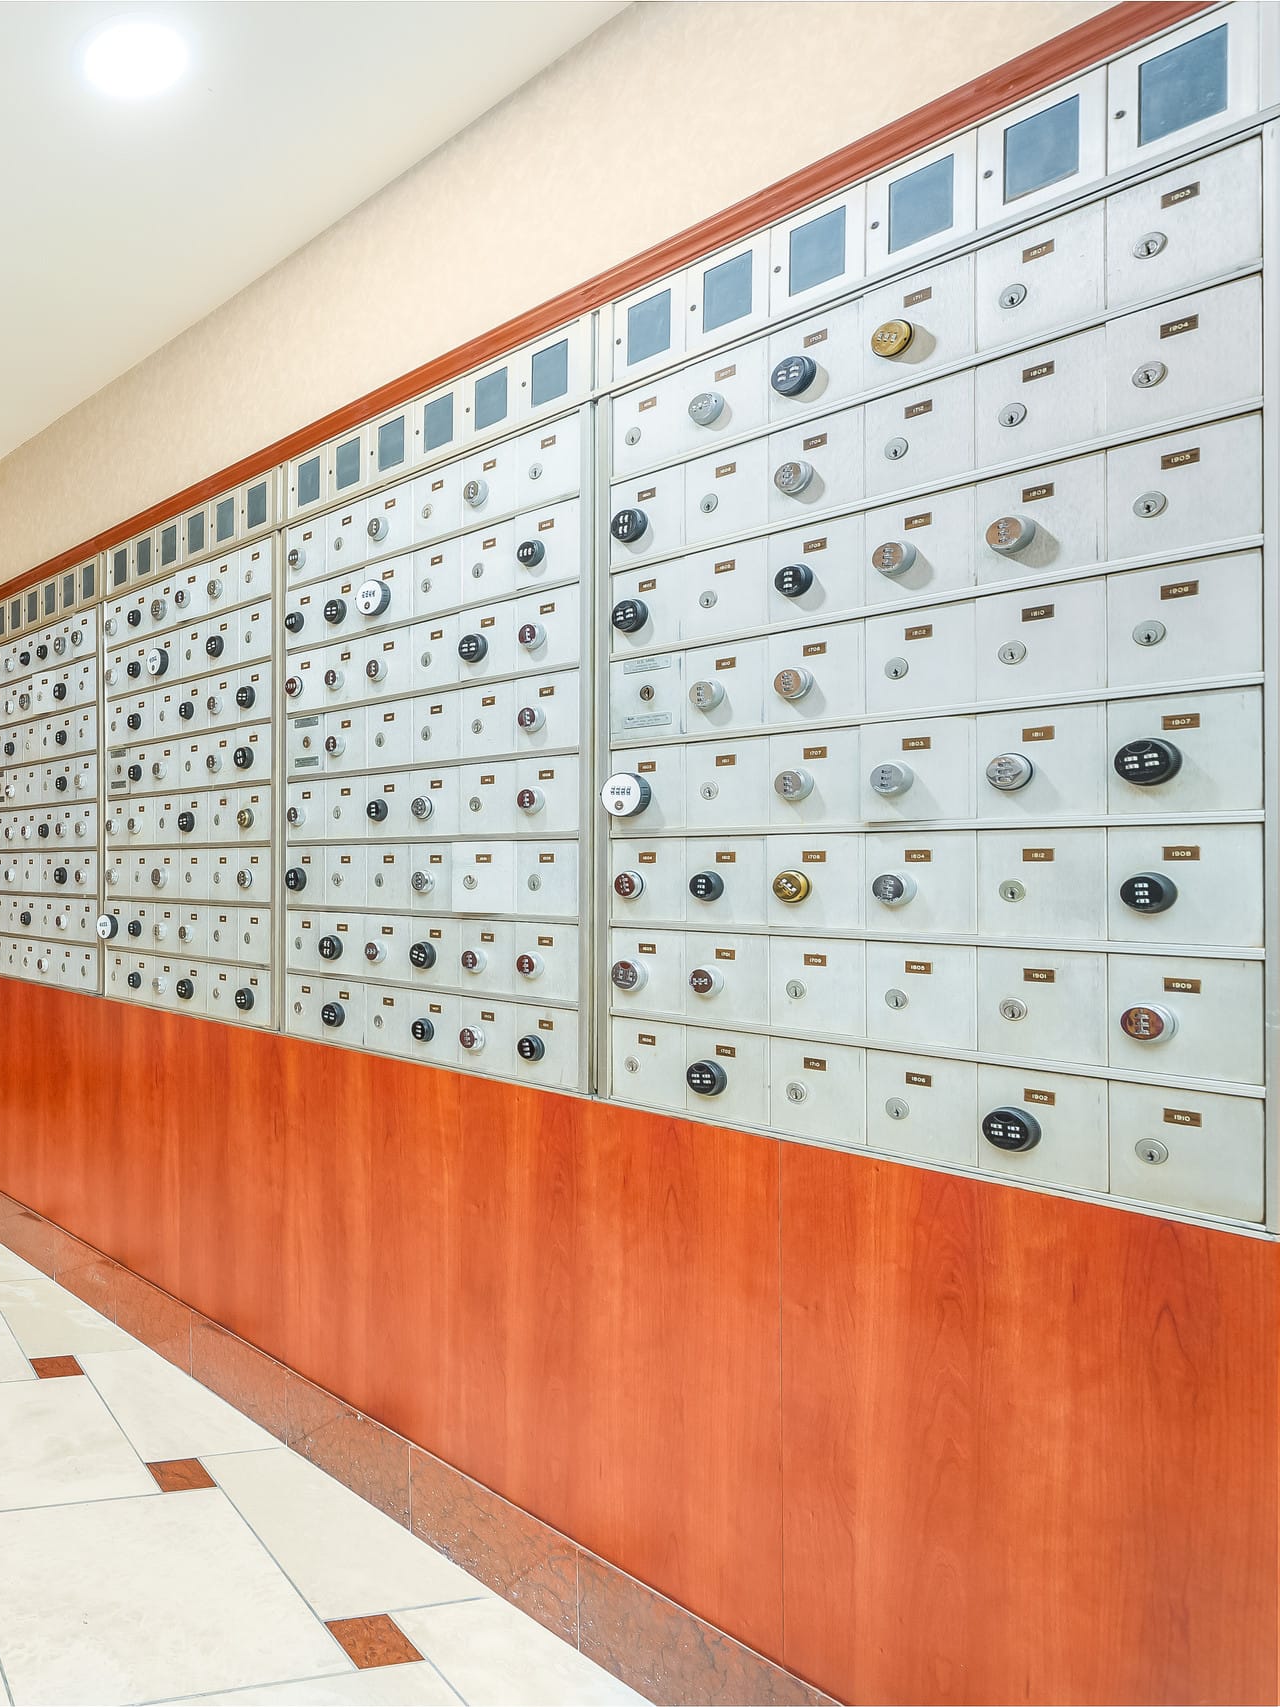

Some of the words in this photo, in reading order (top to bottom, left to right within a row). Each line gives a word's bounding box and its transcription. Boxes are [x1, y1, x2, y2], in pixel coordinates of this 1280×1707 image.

[1171, 189, 1191, 201] 1903
[1169, 321, 1189, 332] 1904
[1171, 454, 1191, 464] 1905
[1169, 586, 1189, 594] 1906
[1172, 718, 1191, 726] 1907
